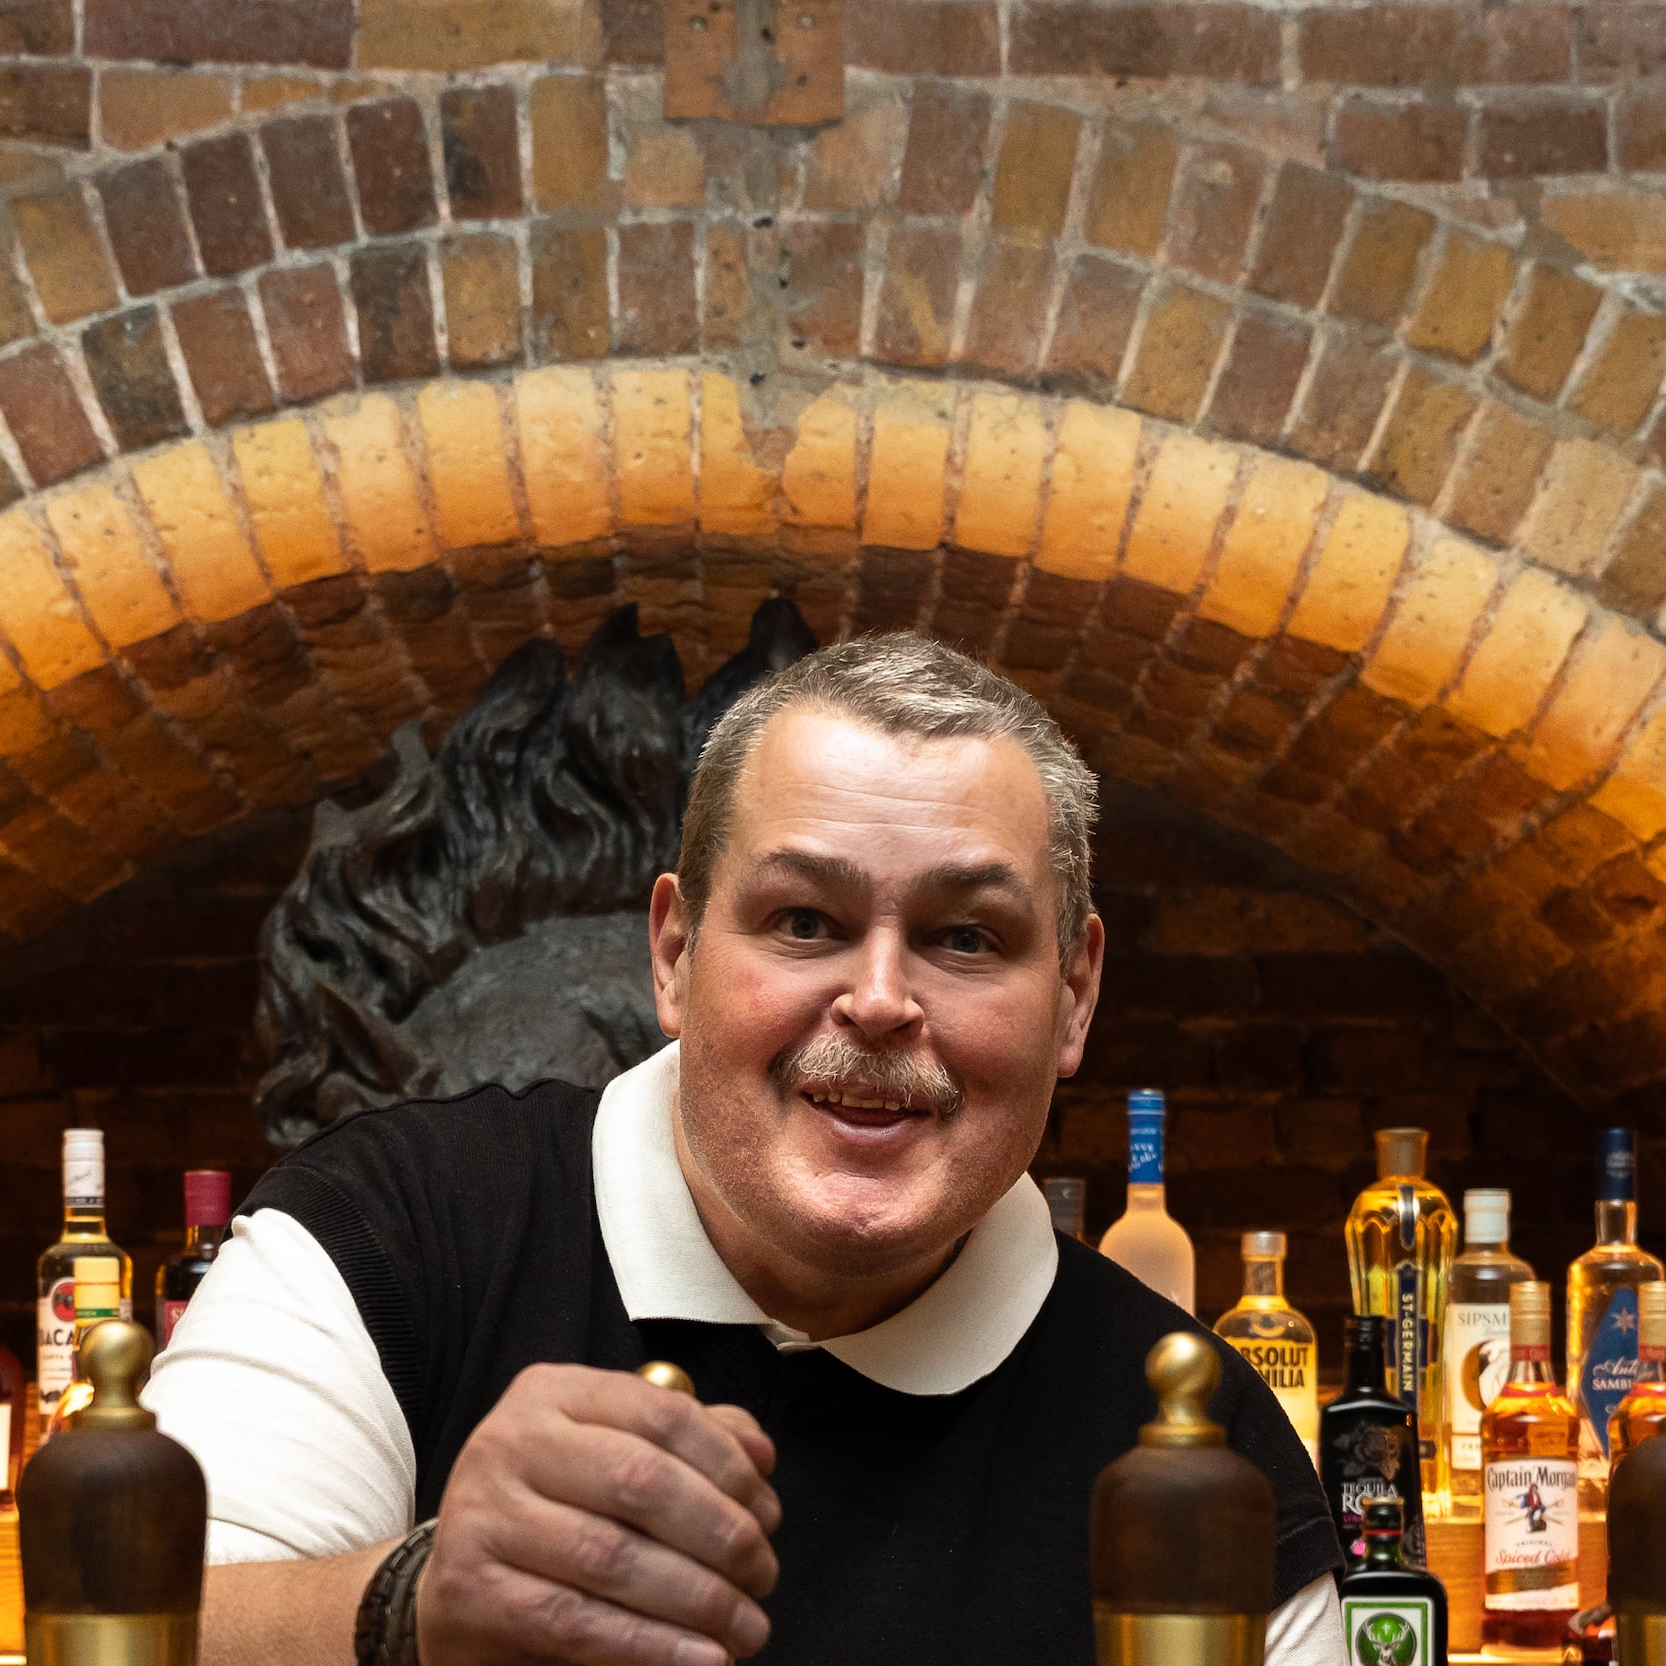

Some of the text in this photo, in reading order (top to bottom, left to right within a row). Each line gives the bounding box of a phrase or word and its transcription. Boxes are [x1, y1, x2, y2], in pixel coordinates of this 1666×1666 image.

[1456, 1311, 1510, 1326] SIPSM
[1401, 1292, 1415, 1394] ST-GERMAIN
[1486, 1466, 1533, 1493] Captain
[1341, 1481, 1399, 1498] TEQUILA
[1494, 1548, 1542, 1566] Spiced
